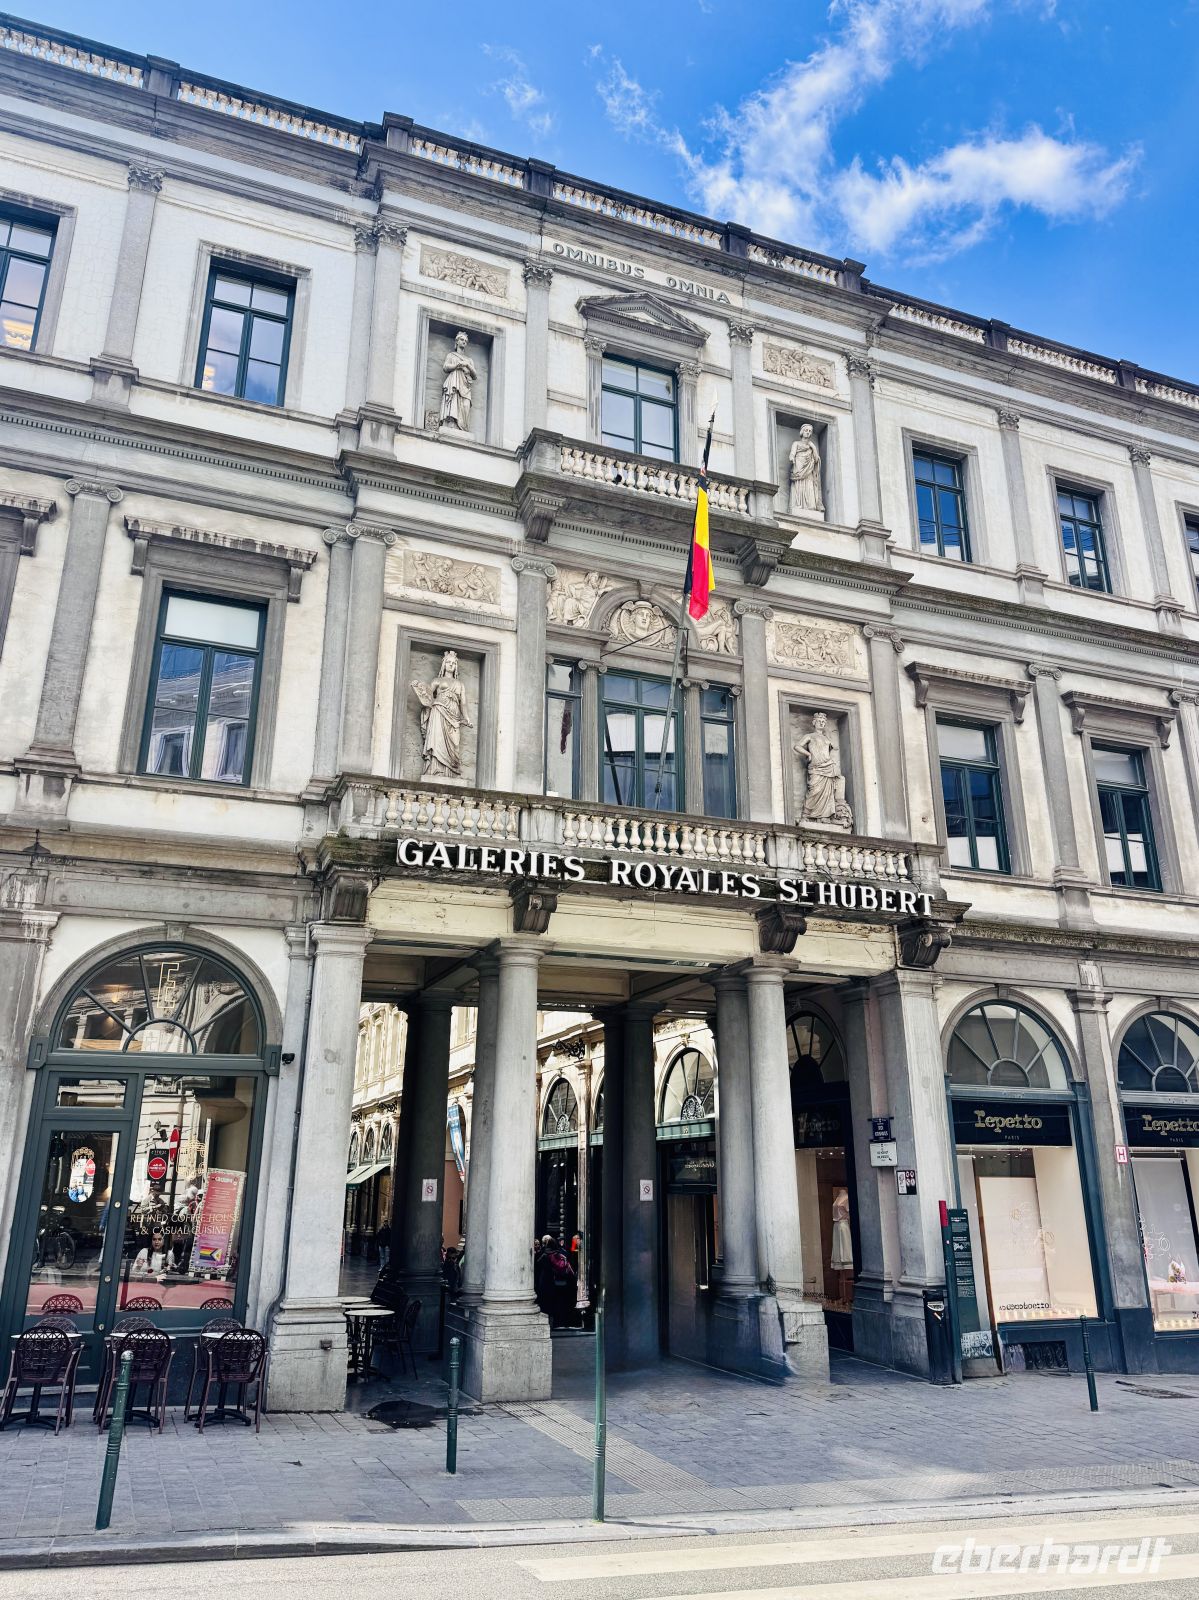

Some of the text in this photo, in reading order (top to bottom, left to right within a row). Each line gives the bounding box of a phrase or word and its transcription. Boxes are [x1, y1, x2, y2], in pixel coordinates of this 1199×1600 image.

[553, 243, 731, 304] OMNIBUS OMNIA
[398, 838, 585, 881] GALERIES
[610, 859, 761, 898] ROYALES
[818, 882, 935, 916] HUBERT
[130, 1214, 168, 1222] REFINED
[171, 1213, 207, 1222] COFFEE
[141, 1226, 226, 1235] & CASUAL CUISINE
